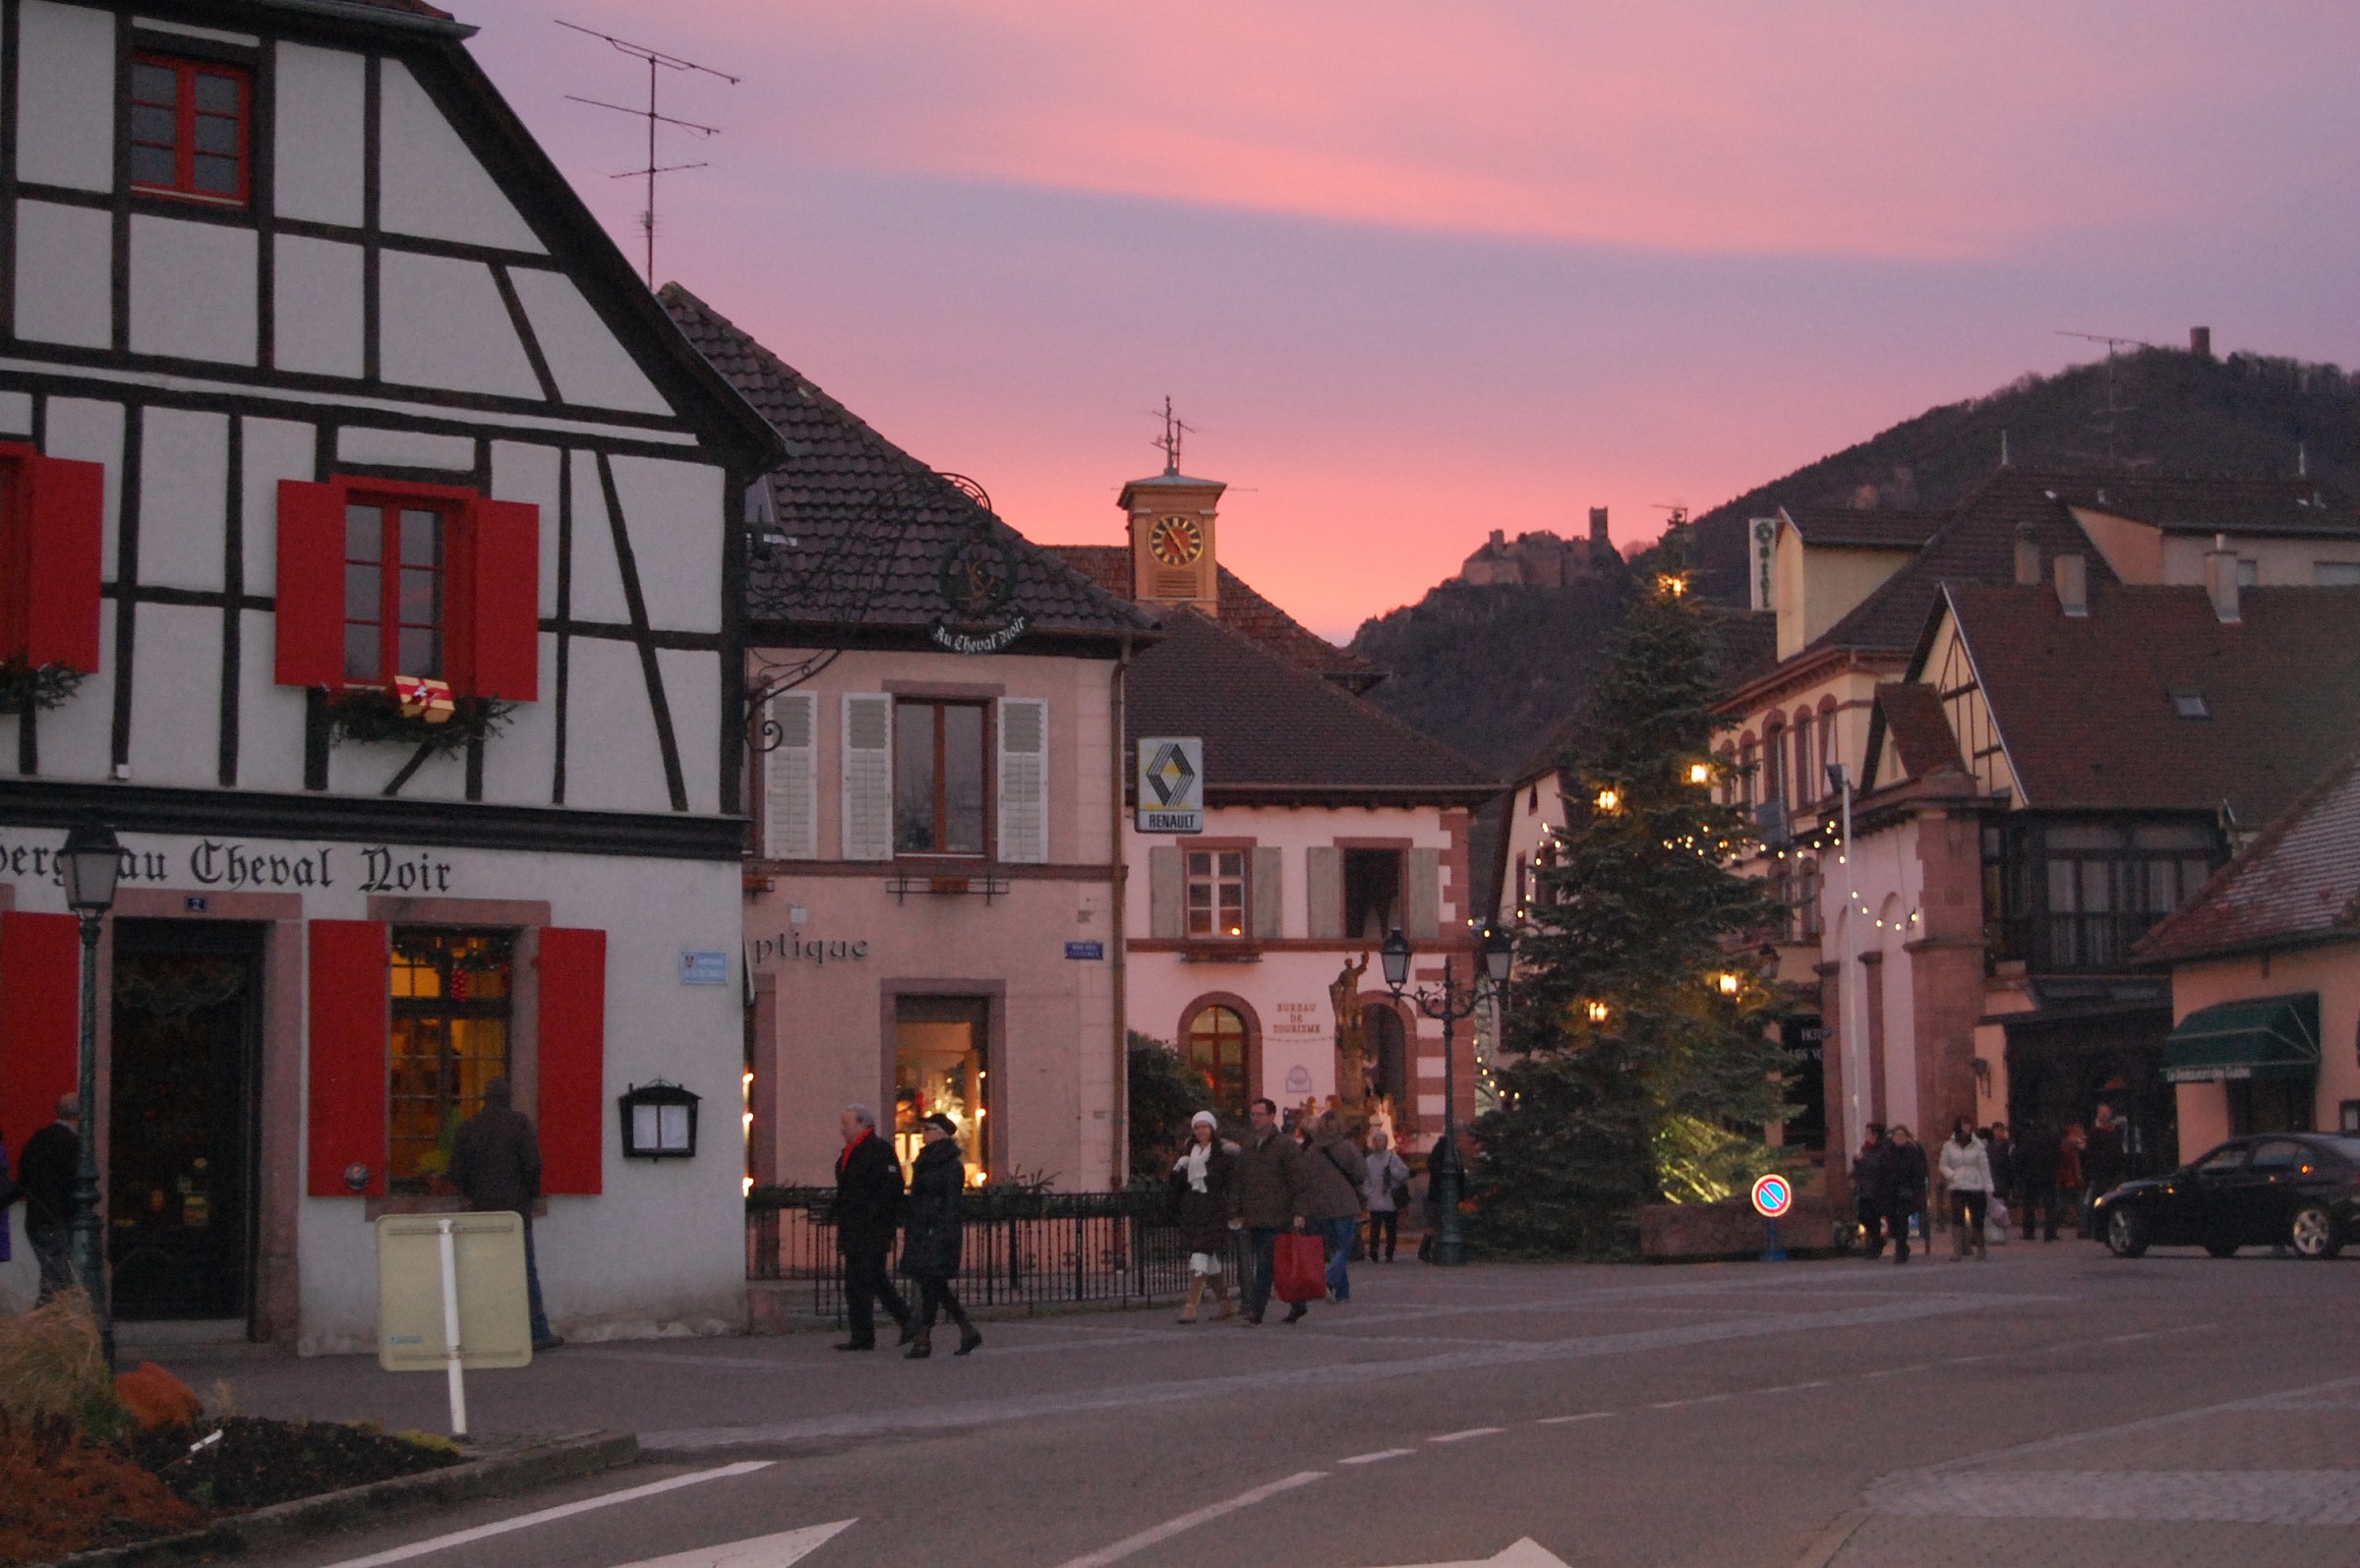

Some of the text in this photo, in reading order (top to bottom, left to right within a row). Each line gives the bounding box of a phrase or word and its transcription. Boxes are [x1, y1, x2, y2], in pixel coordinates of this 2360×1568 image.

[931, 624, 952, 646] Au
[954, 632, 997, 655] Cheval
[1149, 814, 1195, 829] RENAULT
[115, 850, 167, 882] au
[190, 839, 333, 893] Cheval
[358, 845, 450, 893] Noir
[755, 931, 868, 964] ptique
[1277, 1003, 1317, 1013] BUREAU
[1289, 1014, 1303, 1023] DE
